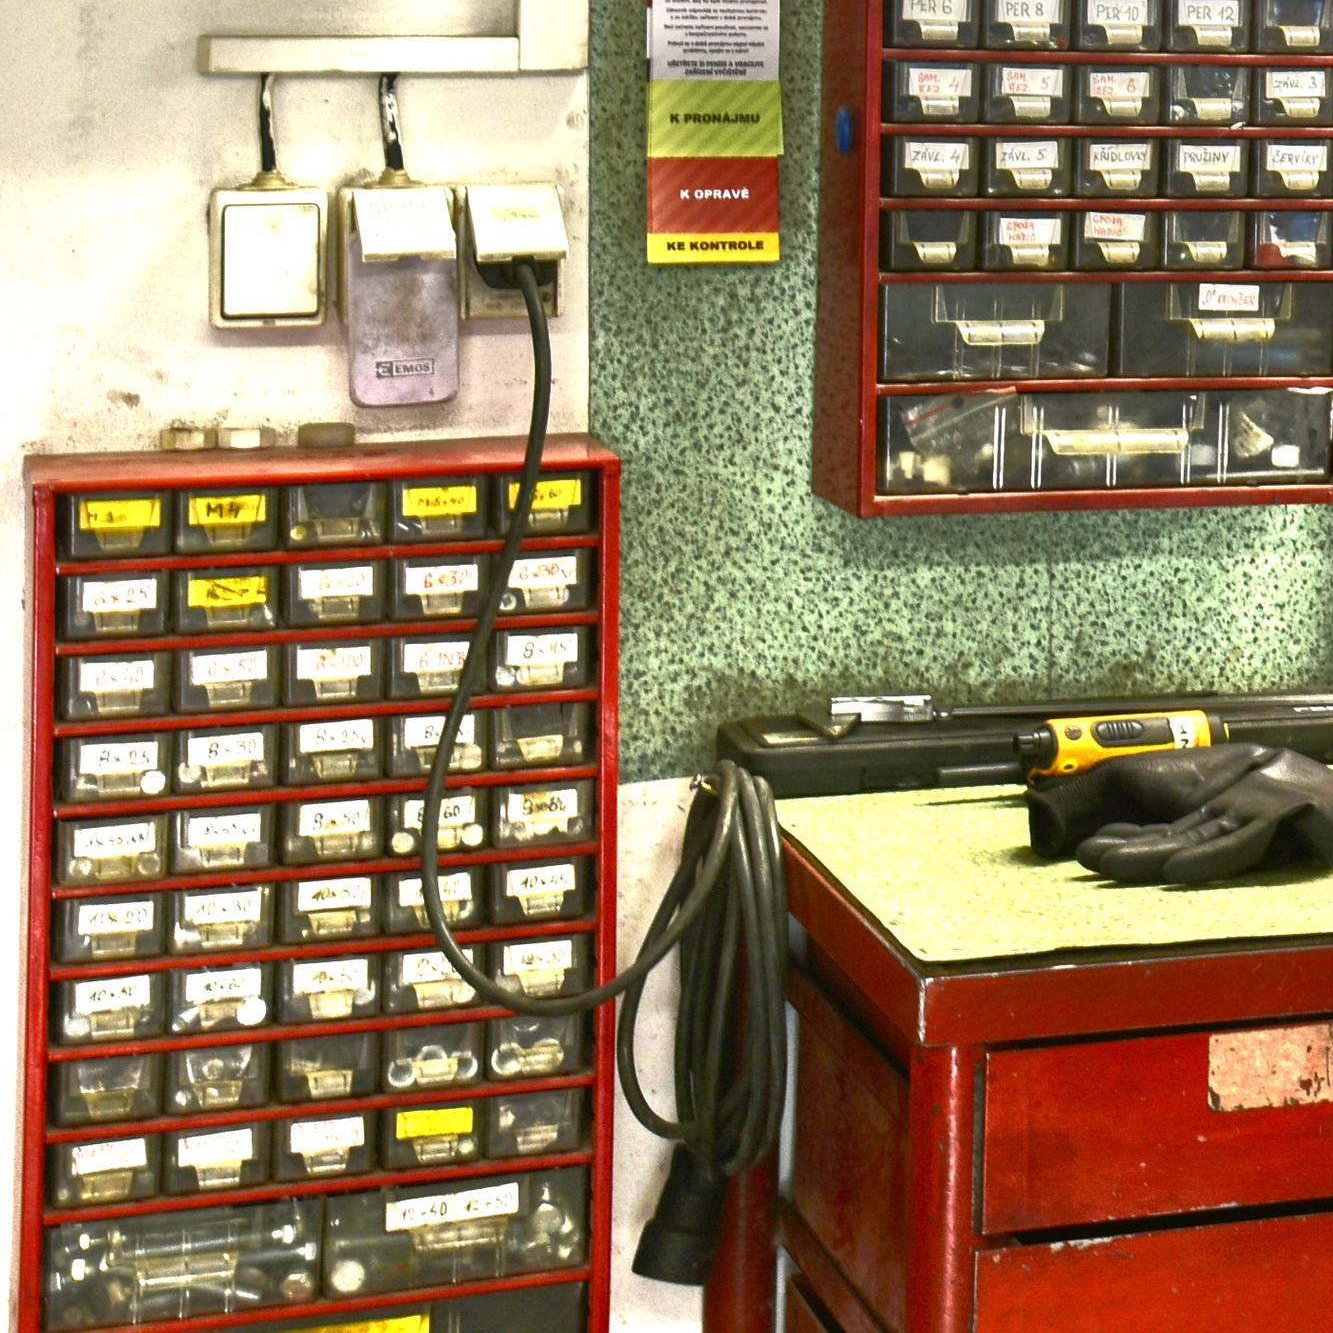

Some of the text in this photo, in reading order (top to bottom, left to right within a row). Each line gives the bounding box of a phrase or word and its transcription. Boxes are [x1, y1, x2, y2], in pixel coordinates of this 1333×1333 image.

[669, 111, 761, 124] K PRONÁJMU
[680, 187, 750, 200] K OPRAVĚ
[666, 240, 764, 251] KE KONTROLE
[393, 361, 432, 375] EMOS
